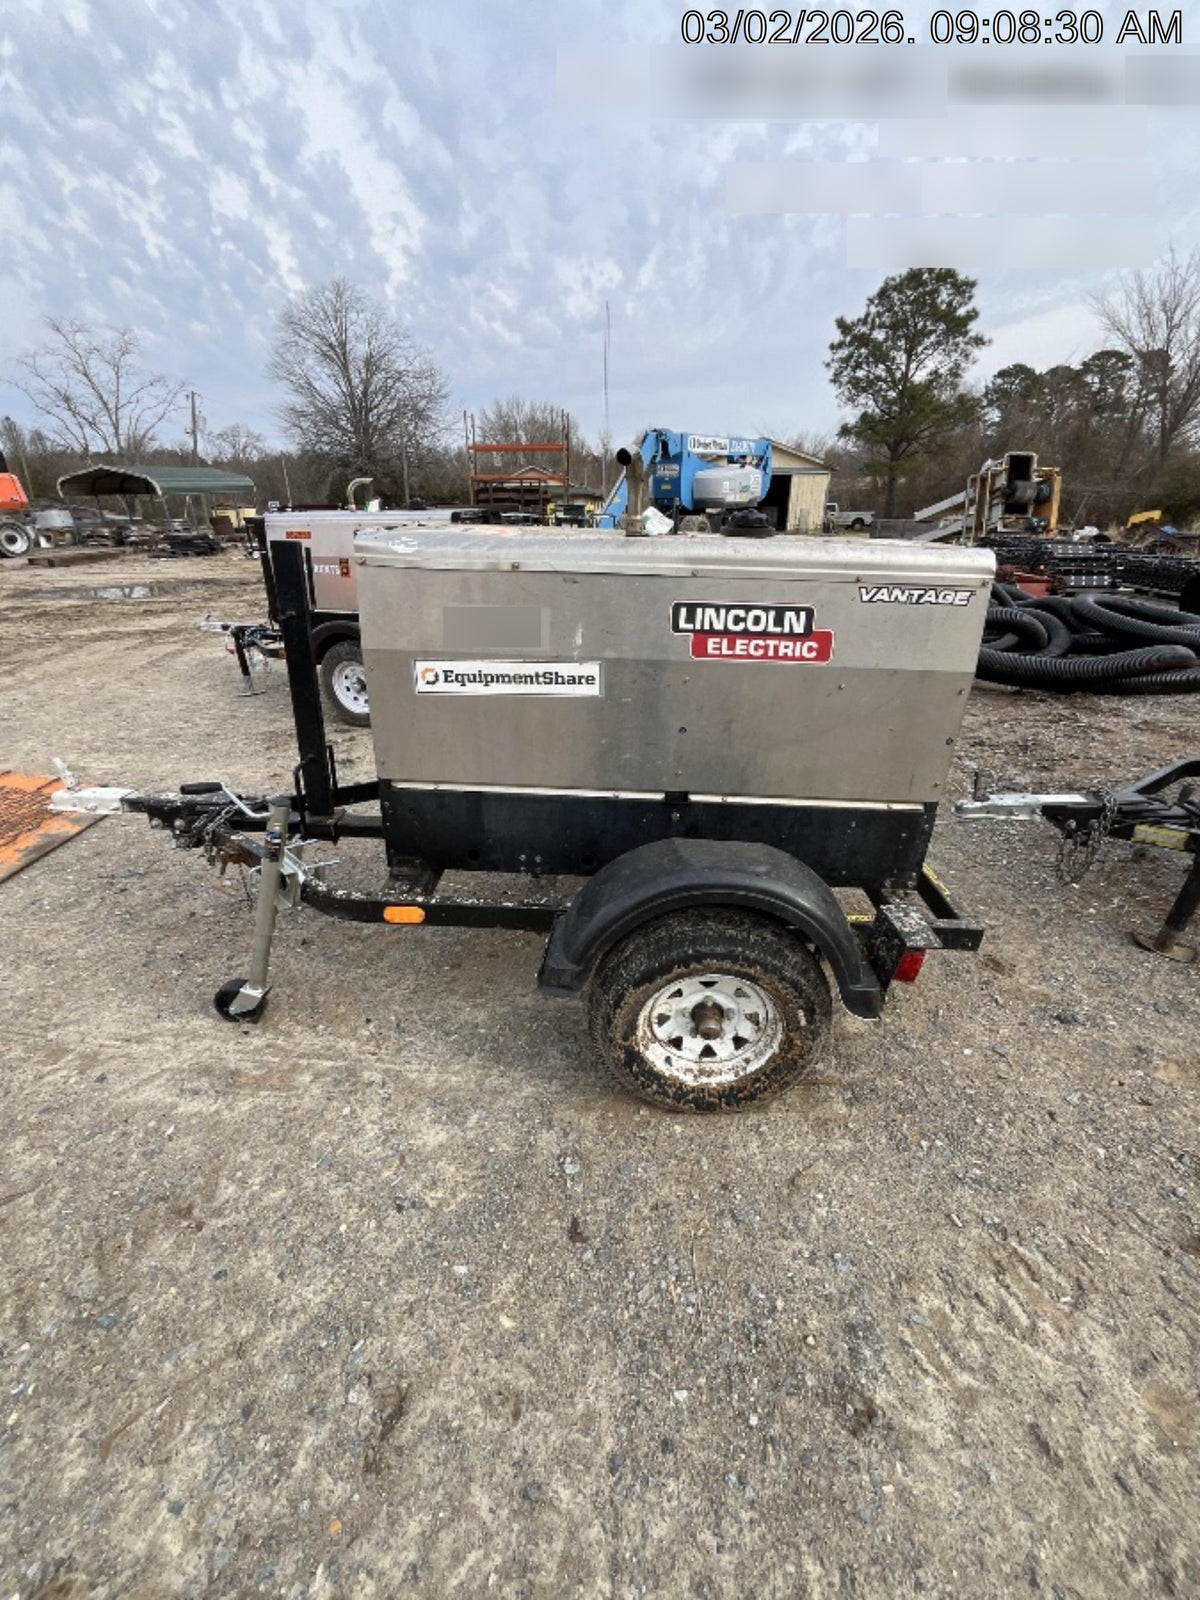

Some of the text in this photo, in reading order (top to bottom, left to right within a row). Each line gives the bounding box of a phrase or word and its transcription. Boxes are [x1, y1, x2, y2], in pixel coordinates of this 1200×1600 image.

[859, 586, 974, 606] VANTAGE
[678, 607, 806, 634] LINCOLN
[706, 637, 819, 658] ELECTRIC
[442, 669, 596, 687] EquipmentShare
